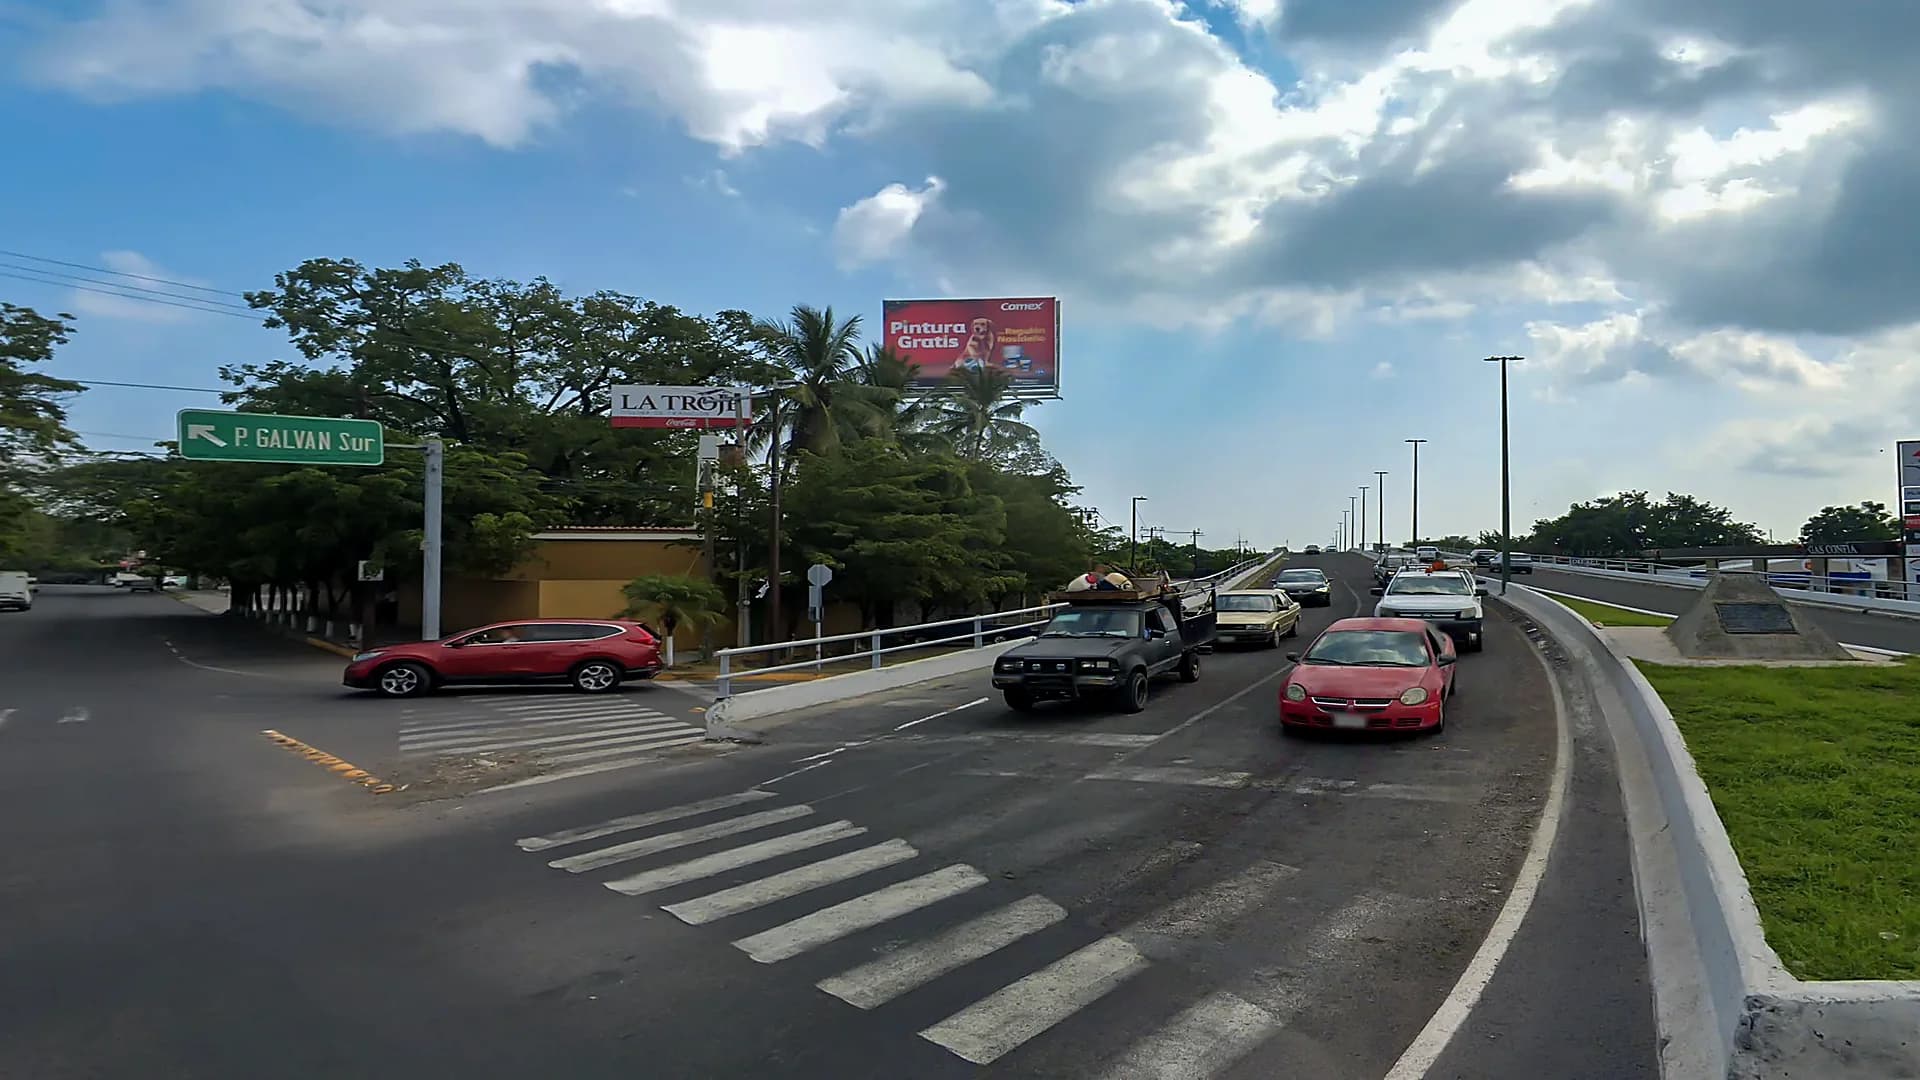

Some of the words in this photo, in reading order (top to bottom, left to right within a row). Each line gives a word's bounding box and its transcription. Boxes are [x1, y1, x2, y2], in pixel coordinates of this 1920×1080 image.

[1001, 302, 1044, 311] Comex
[891, 320, 966, 335] Pintura
[898, 335, 960, 349] Gratis
[621, 395, 656, 410] LA
[235, 428, 249, 447] P.
[256, 429, 331, 450] GALVAN
[339, 433, 376, 452] Sur
